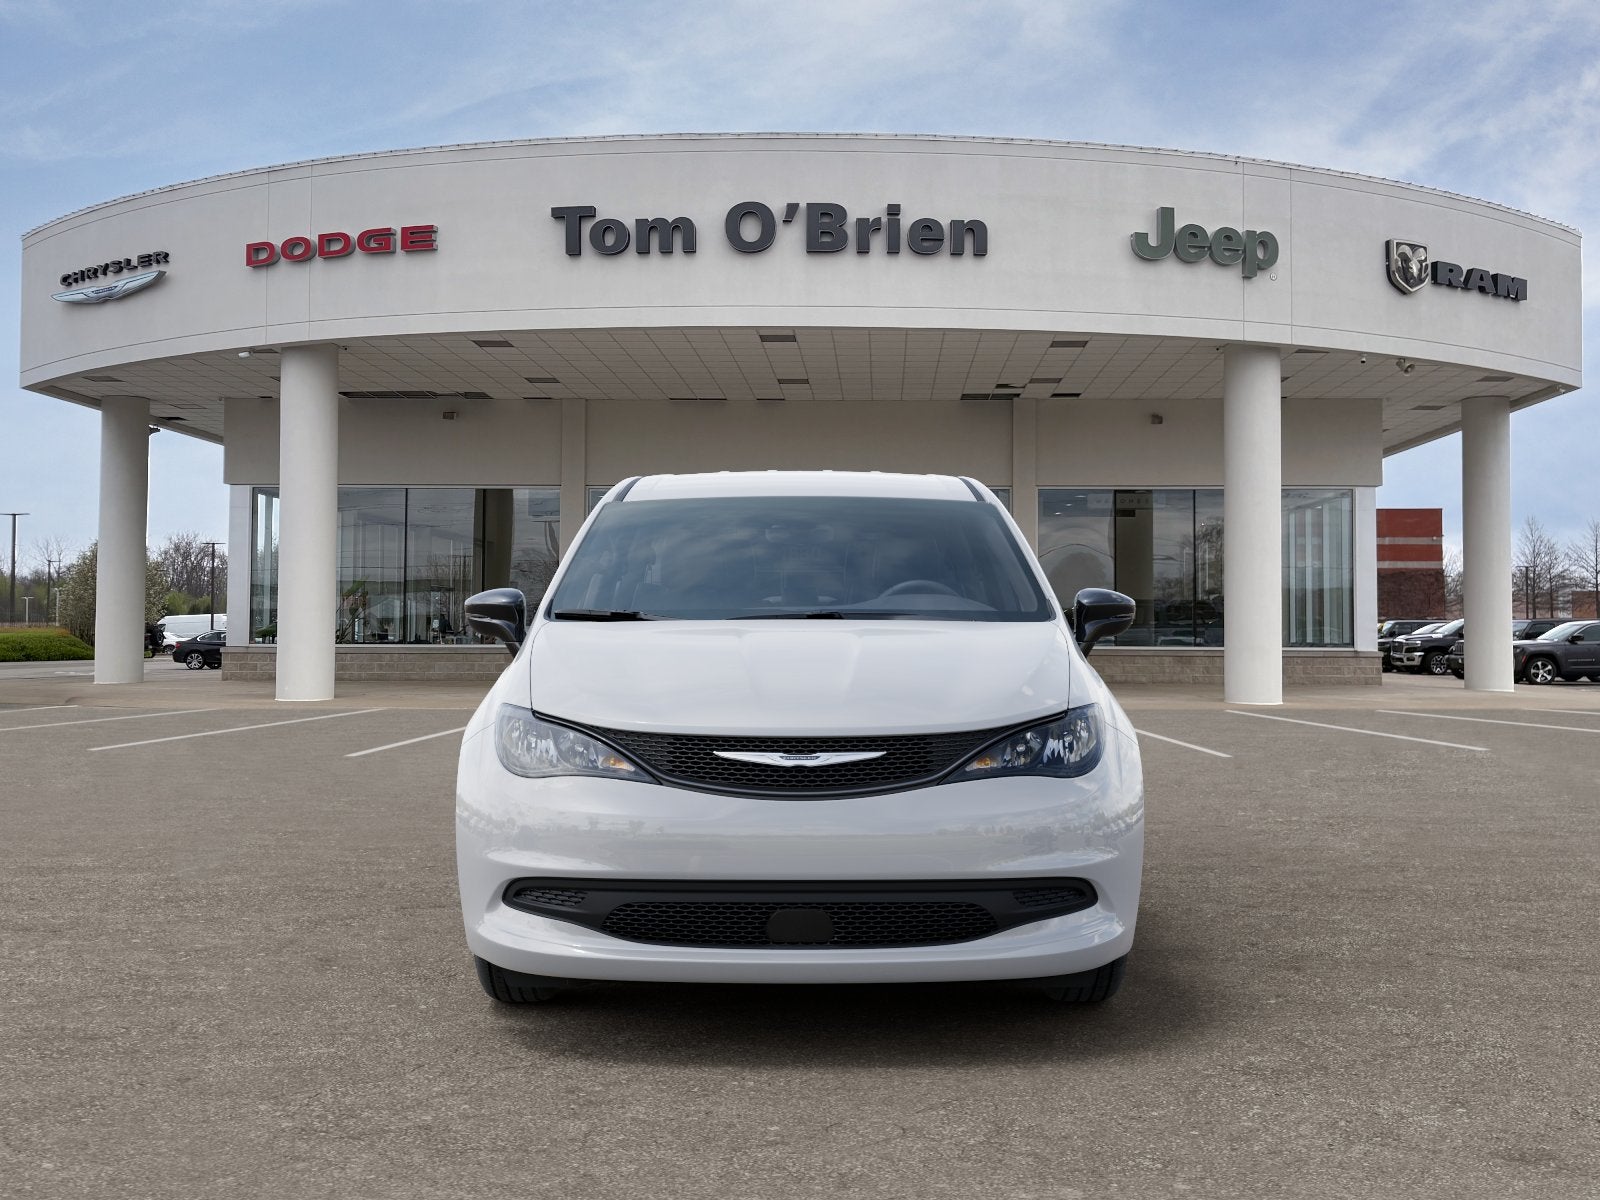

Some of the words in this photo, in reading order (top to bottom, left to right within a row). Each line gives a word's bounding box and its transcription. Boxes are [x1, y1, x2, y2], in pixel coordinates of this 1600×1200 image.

[246, 225, 438, 268] DODGE
[551, 205, 697, 256] Tom
[725, 201, 988, 256] O'Brien
[1131, 207, 1279, 279] Jeep
[60, 251, 170, 287] CHRYSLER
[1431, 261, 1528, 301] RAM
